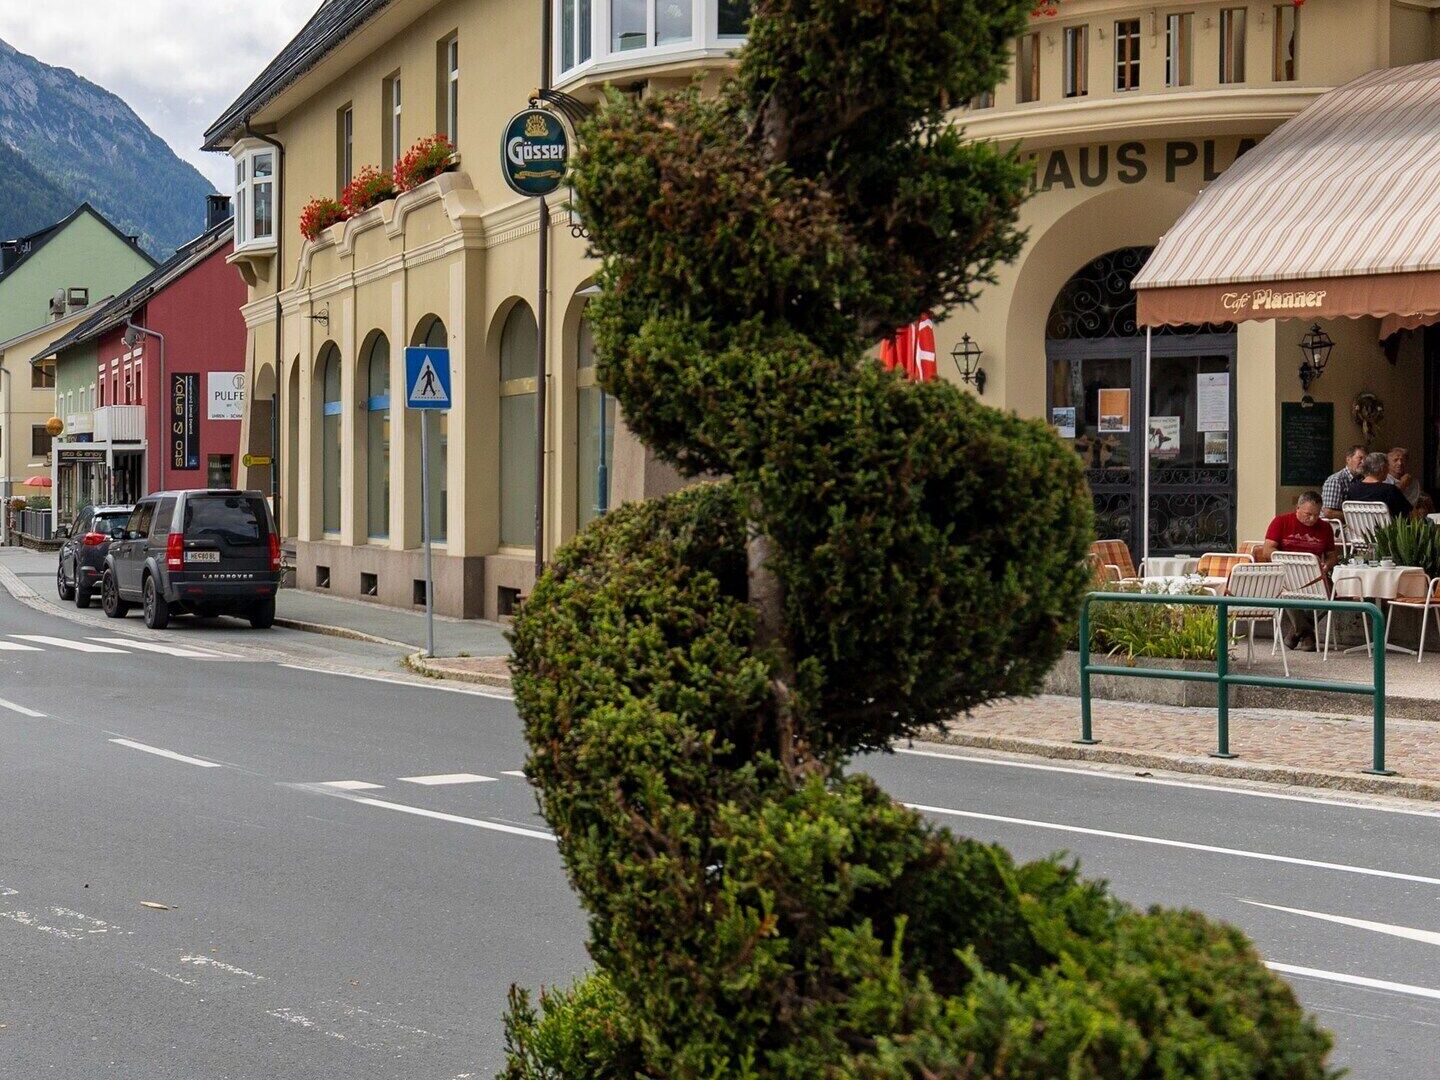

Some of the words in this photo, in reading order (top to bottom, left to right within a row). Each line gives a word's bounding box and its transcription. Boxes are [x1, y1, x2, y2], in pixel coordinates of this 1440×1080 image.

[507, 136, 565, 167] Gösser
[1165, 137, 1257, 183] PL
[1252, 288, 1327, 310] Planner
[173, 375, 185, 415] enjoy
[173, 421, 183, 434] &
[175, 440, 183, 467] sto
